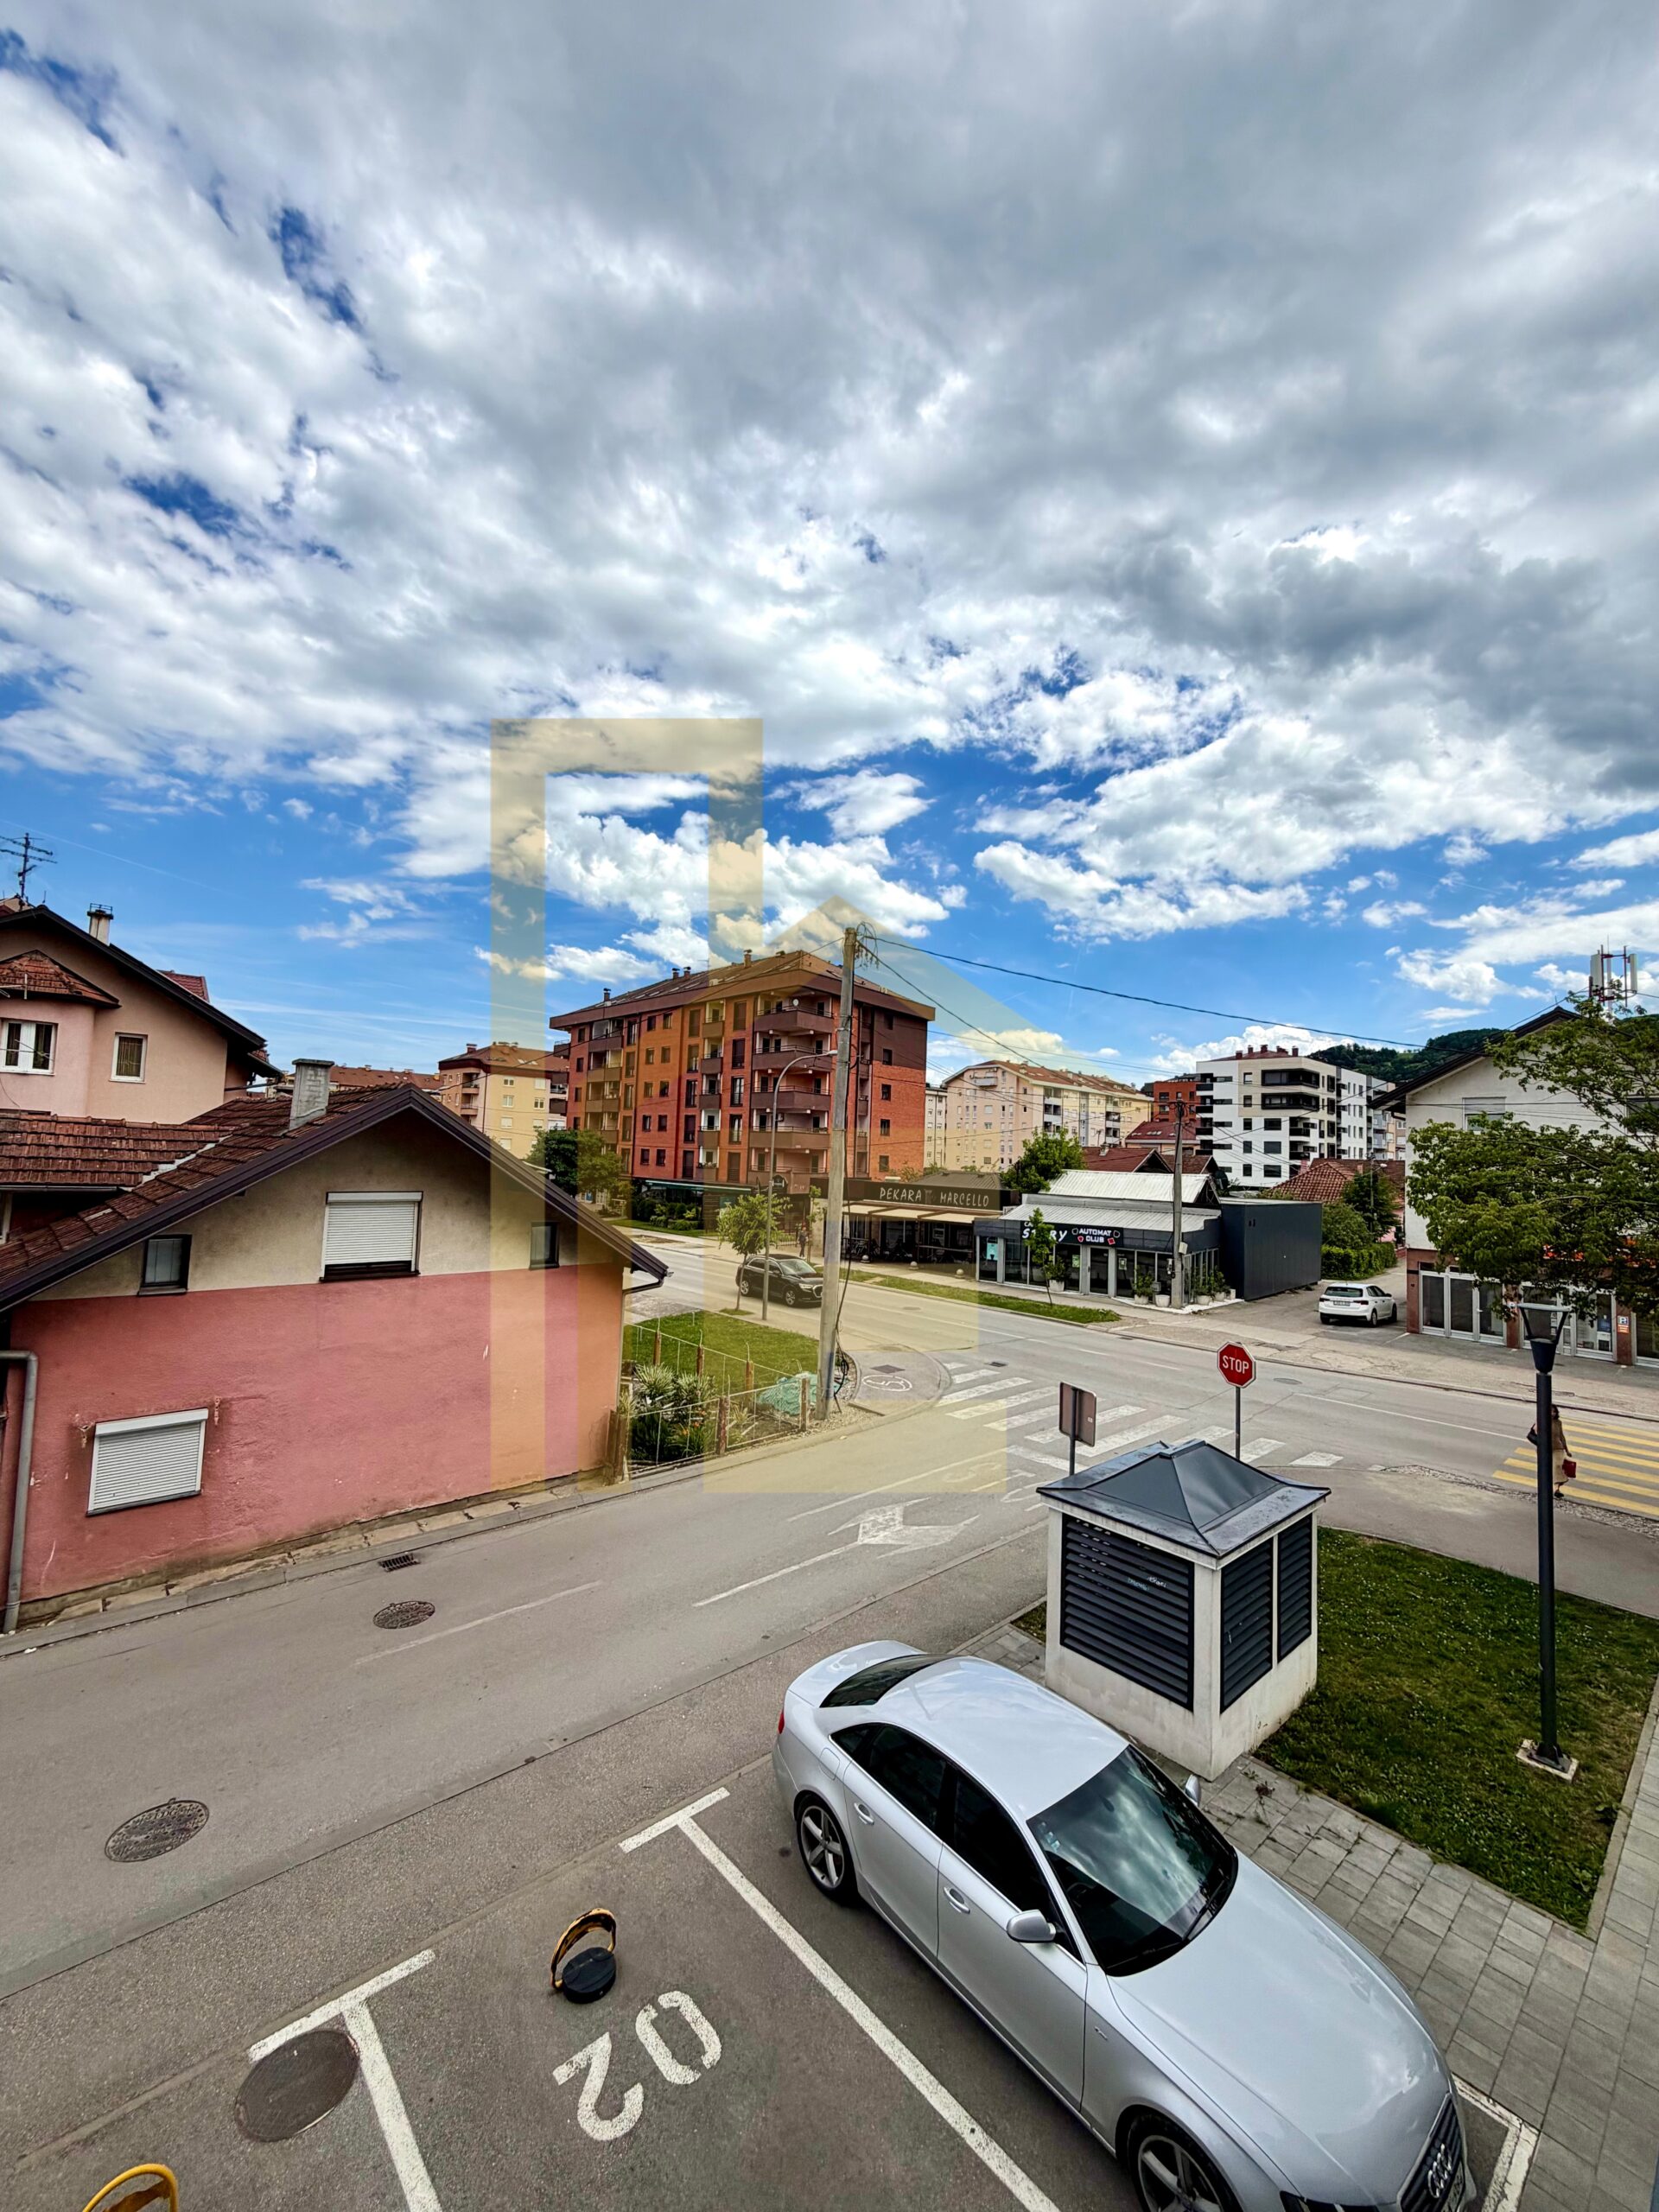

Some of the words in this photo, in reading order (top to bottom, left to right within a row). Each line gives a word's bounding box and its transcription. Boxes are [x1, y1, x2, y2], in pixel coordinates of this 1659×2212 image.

[880, 1187, 922, 1202] PEKARA
[939, 1192, 989, 1207] MARCELLO
[1021, 1228, 1068, 1243] STRY
[1078, 1228, 1112, 1236] AUTOMAT
[1222, 1355, 1249, 1374] STOP
[942, 1462, 1055, 1512] STO
